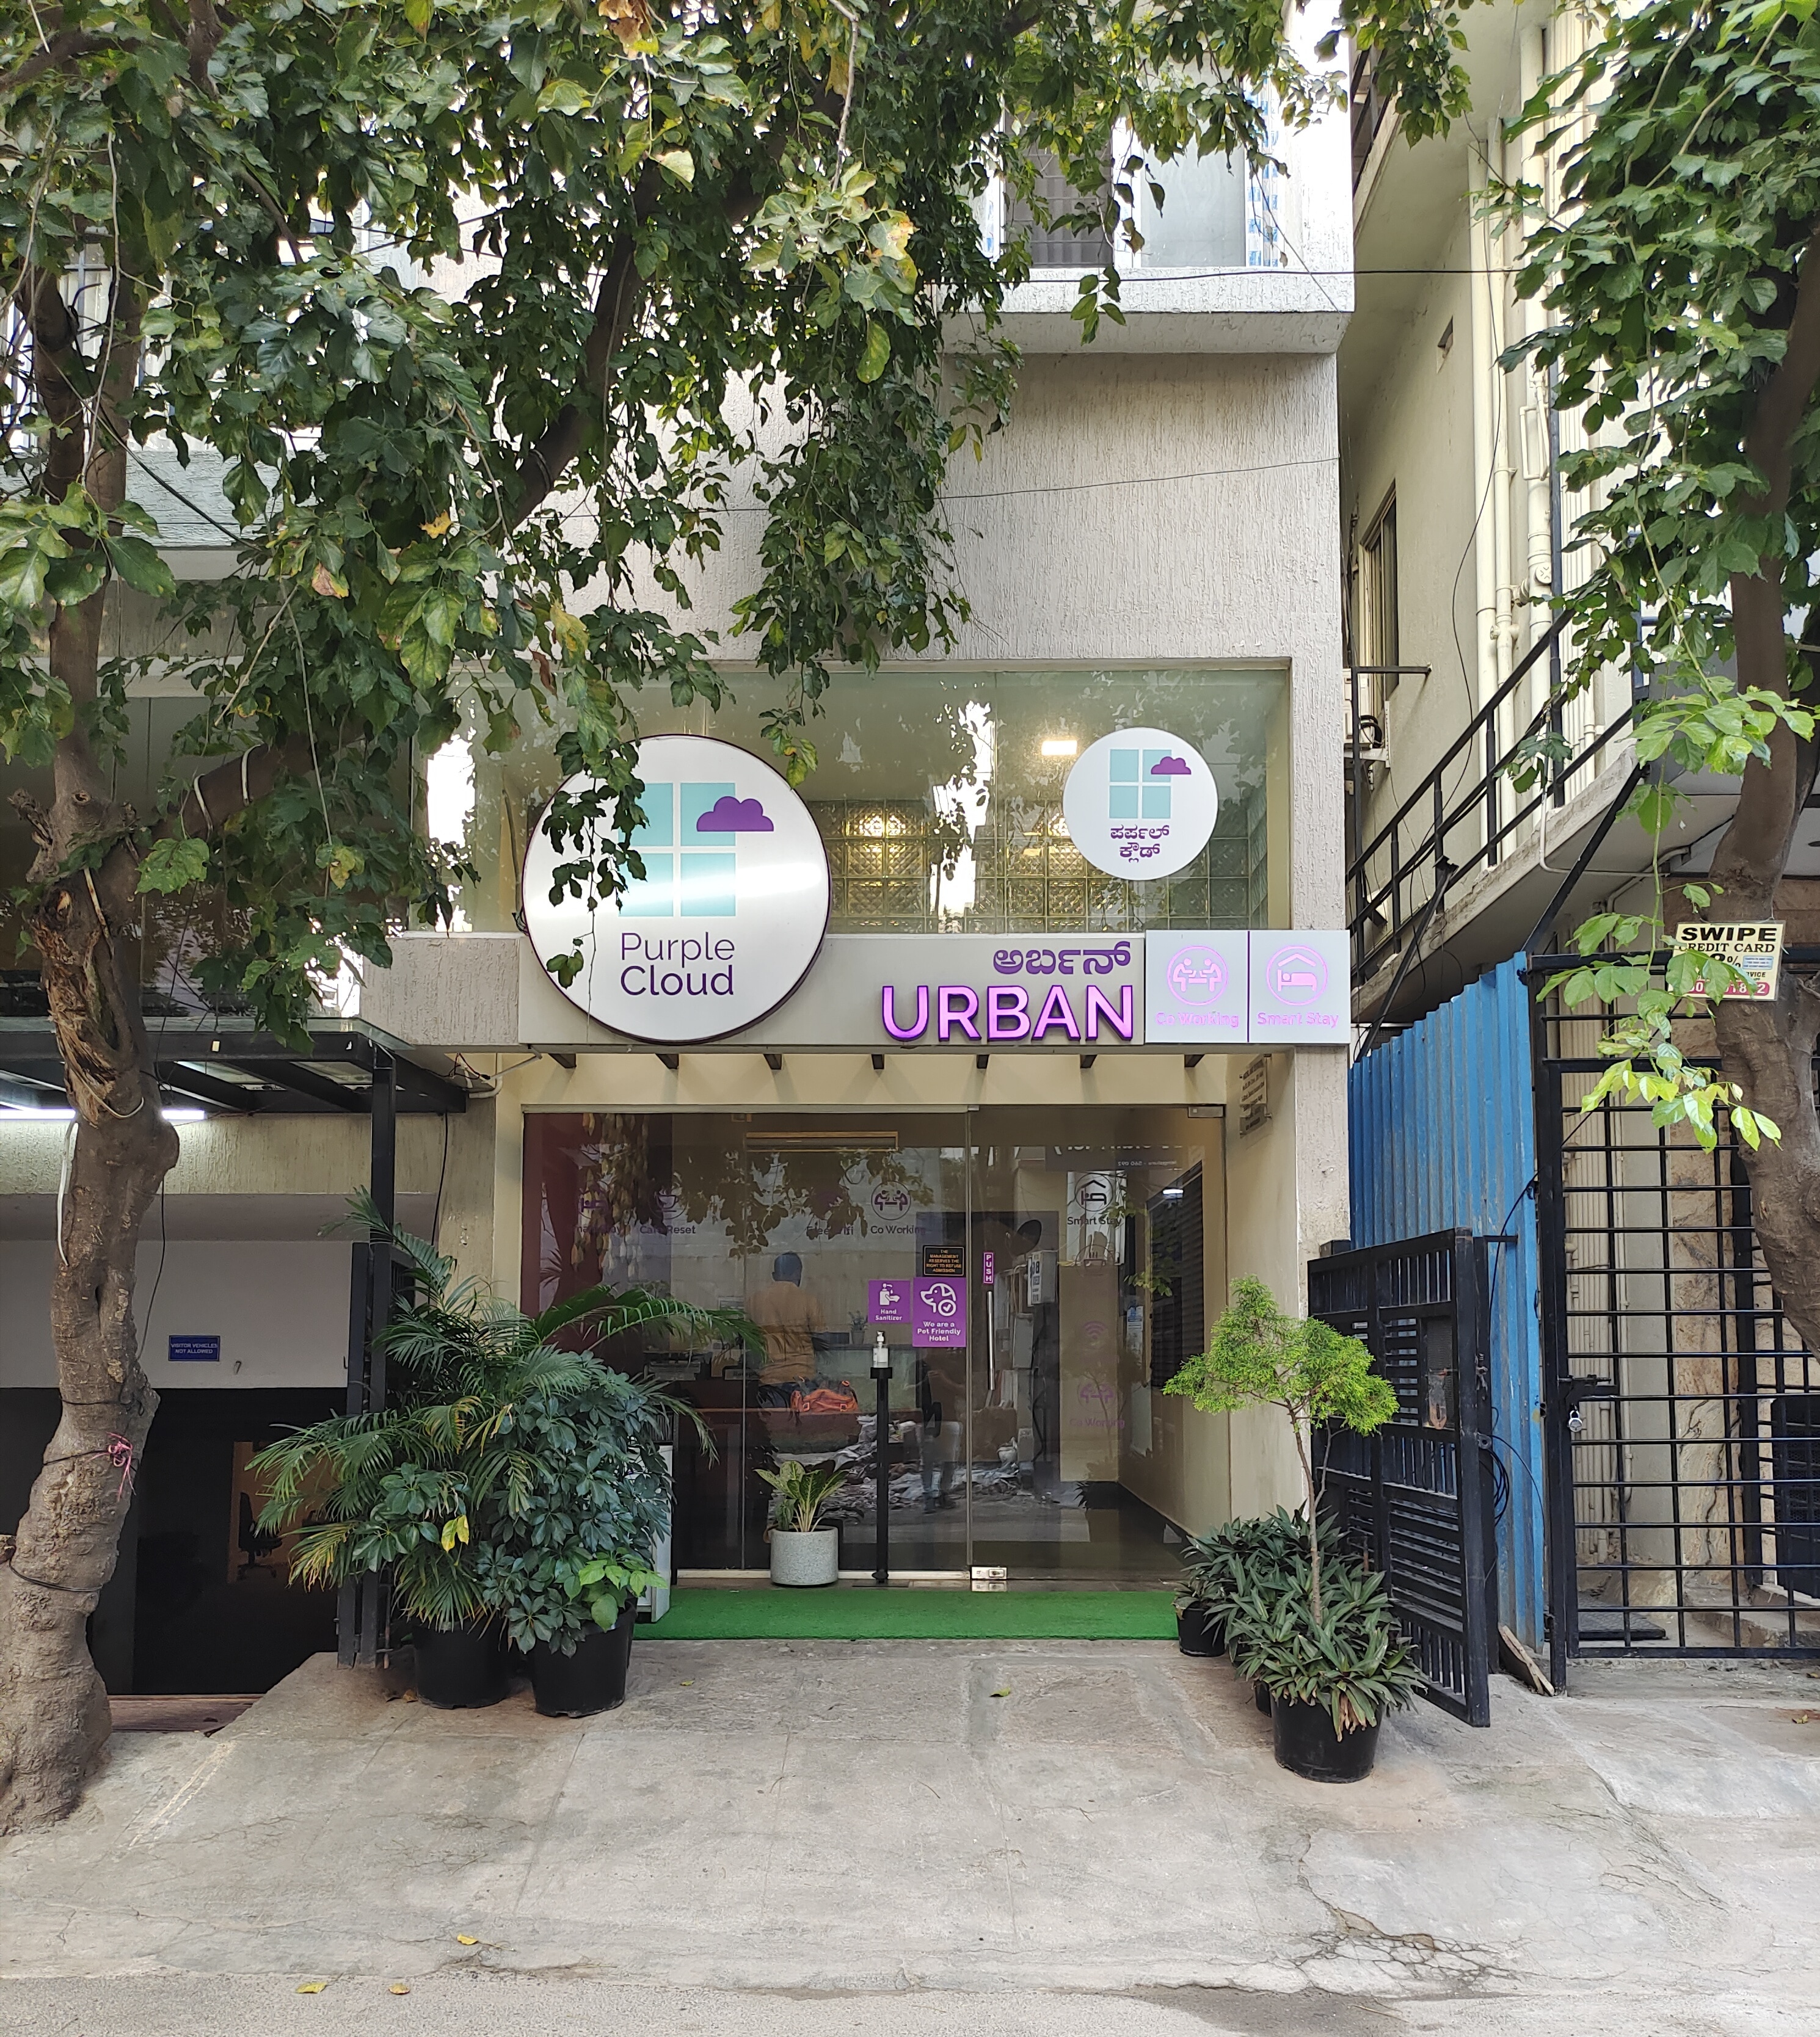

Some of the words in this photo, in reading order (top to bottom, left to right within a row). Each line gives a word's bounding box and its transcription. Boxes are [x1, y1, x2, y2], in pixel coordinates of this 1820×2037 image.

[1110, 824, 1170, 839] ಪರ್ಪಲ್
[1119, 842, 1160, 863] ಕ್ಲೌಡ್
[1681, 927, 1777, 942] SWIPE
[621, 932, 735, 968] Purple
[1680, 943, 1728, 952] CREDIT
[1734, 943, 1775, 953] CARD
[993, 941, 1130, 975] ಅರ್ಬನ್
[621, 965, 734, 996] Cloud
[882, 985, 1133, 1042] URBAN
[1156, 1012, 1175, 1026] Co
[1178, 1012, 1239, 1029] Working
[1257, 1012, 1303, 1026] Smart
[1306, 1012, 1339, 1028] Stay
[668, 1225, 696, 1234] Reset
[870, 1225, 883, 1234] Co
[886, 1225, 926, 1237] Working
